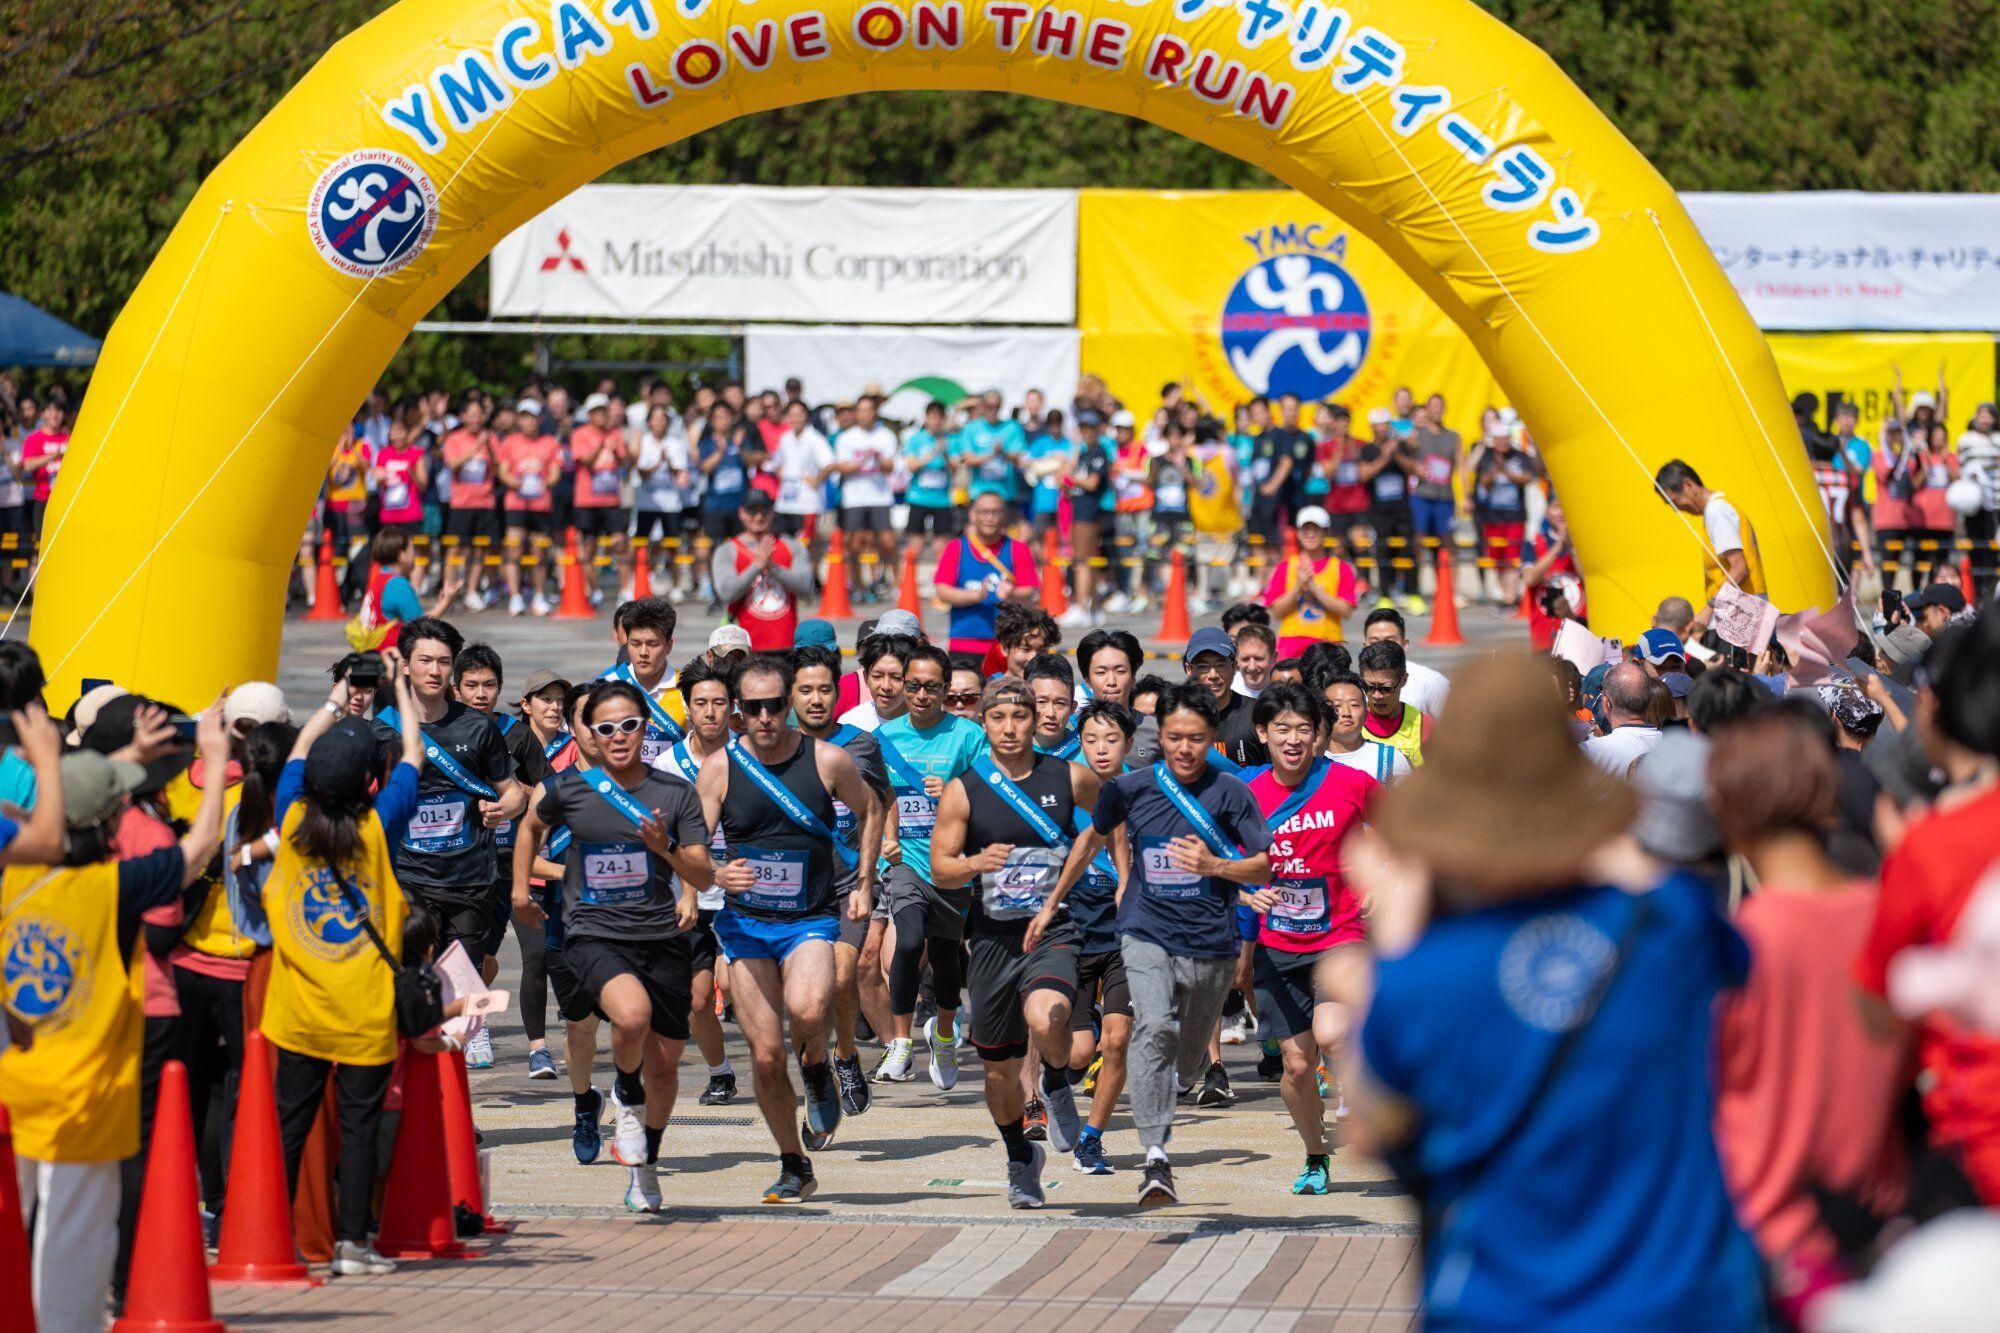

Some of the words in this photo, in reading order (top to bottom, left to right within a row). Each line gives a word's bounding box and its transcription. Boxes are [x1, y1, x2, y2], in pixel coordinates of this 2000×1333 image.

[630, 14, 829, 106] LOVE
[855, 5, 959, 49] ON
[989, 5, 1128, 67] THE
[1149, 38, 1290, 127] RUN
[353, 151, 394, 164] Charity
[394, 156, 416, 174] Run
[309, 157, 352, 218] International
[418, 175, 432, 192] for
[309, 221, 327, 252] YMCA
[1244, 223, 1348, 259] YMCA
[601, 239, 792, 279] Mitsubishi
[804, 244, 1029, 292] Corporation
[437, 754, 454, 772] YMCA
[733, 749, 750, 767] YMCA
[747, 763, 783, 799] International
[780, 794, 801, 818] Charity
[611, 790, 630, 808] YMCA
[903, 800, 935, 814] 23-1
[1000, 781, 1018, 800] YMCA
[1015, 797, 1053, 834] International
[420, 808, 454, 824] 01-1
[1162, 774, 1179, 794] YMCA
[1176, 791, 1212, 831] International
[1208, 827, 1224, 849] Charity
[1222, 844, 1234, 858] Run
[1272, 809, 1335, 836] REAM
[446, 837, 464, 848] 2025
[1269, 839, 1294, 857] AS
[596, 859, 634, 875] 24-1
[754, 866, 790, 882] 38-1
[624, 889, 646, 899] 2025
[1181, 887, 1201, 898] 2025
[1281, 891, 1311, 907] 07-1
[777, 900, 798, 909] 2025
[1303, 923, 1322, 932] 2025
